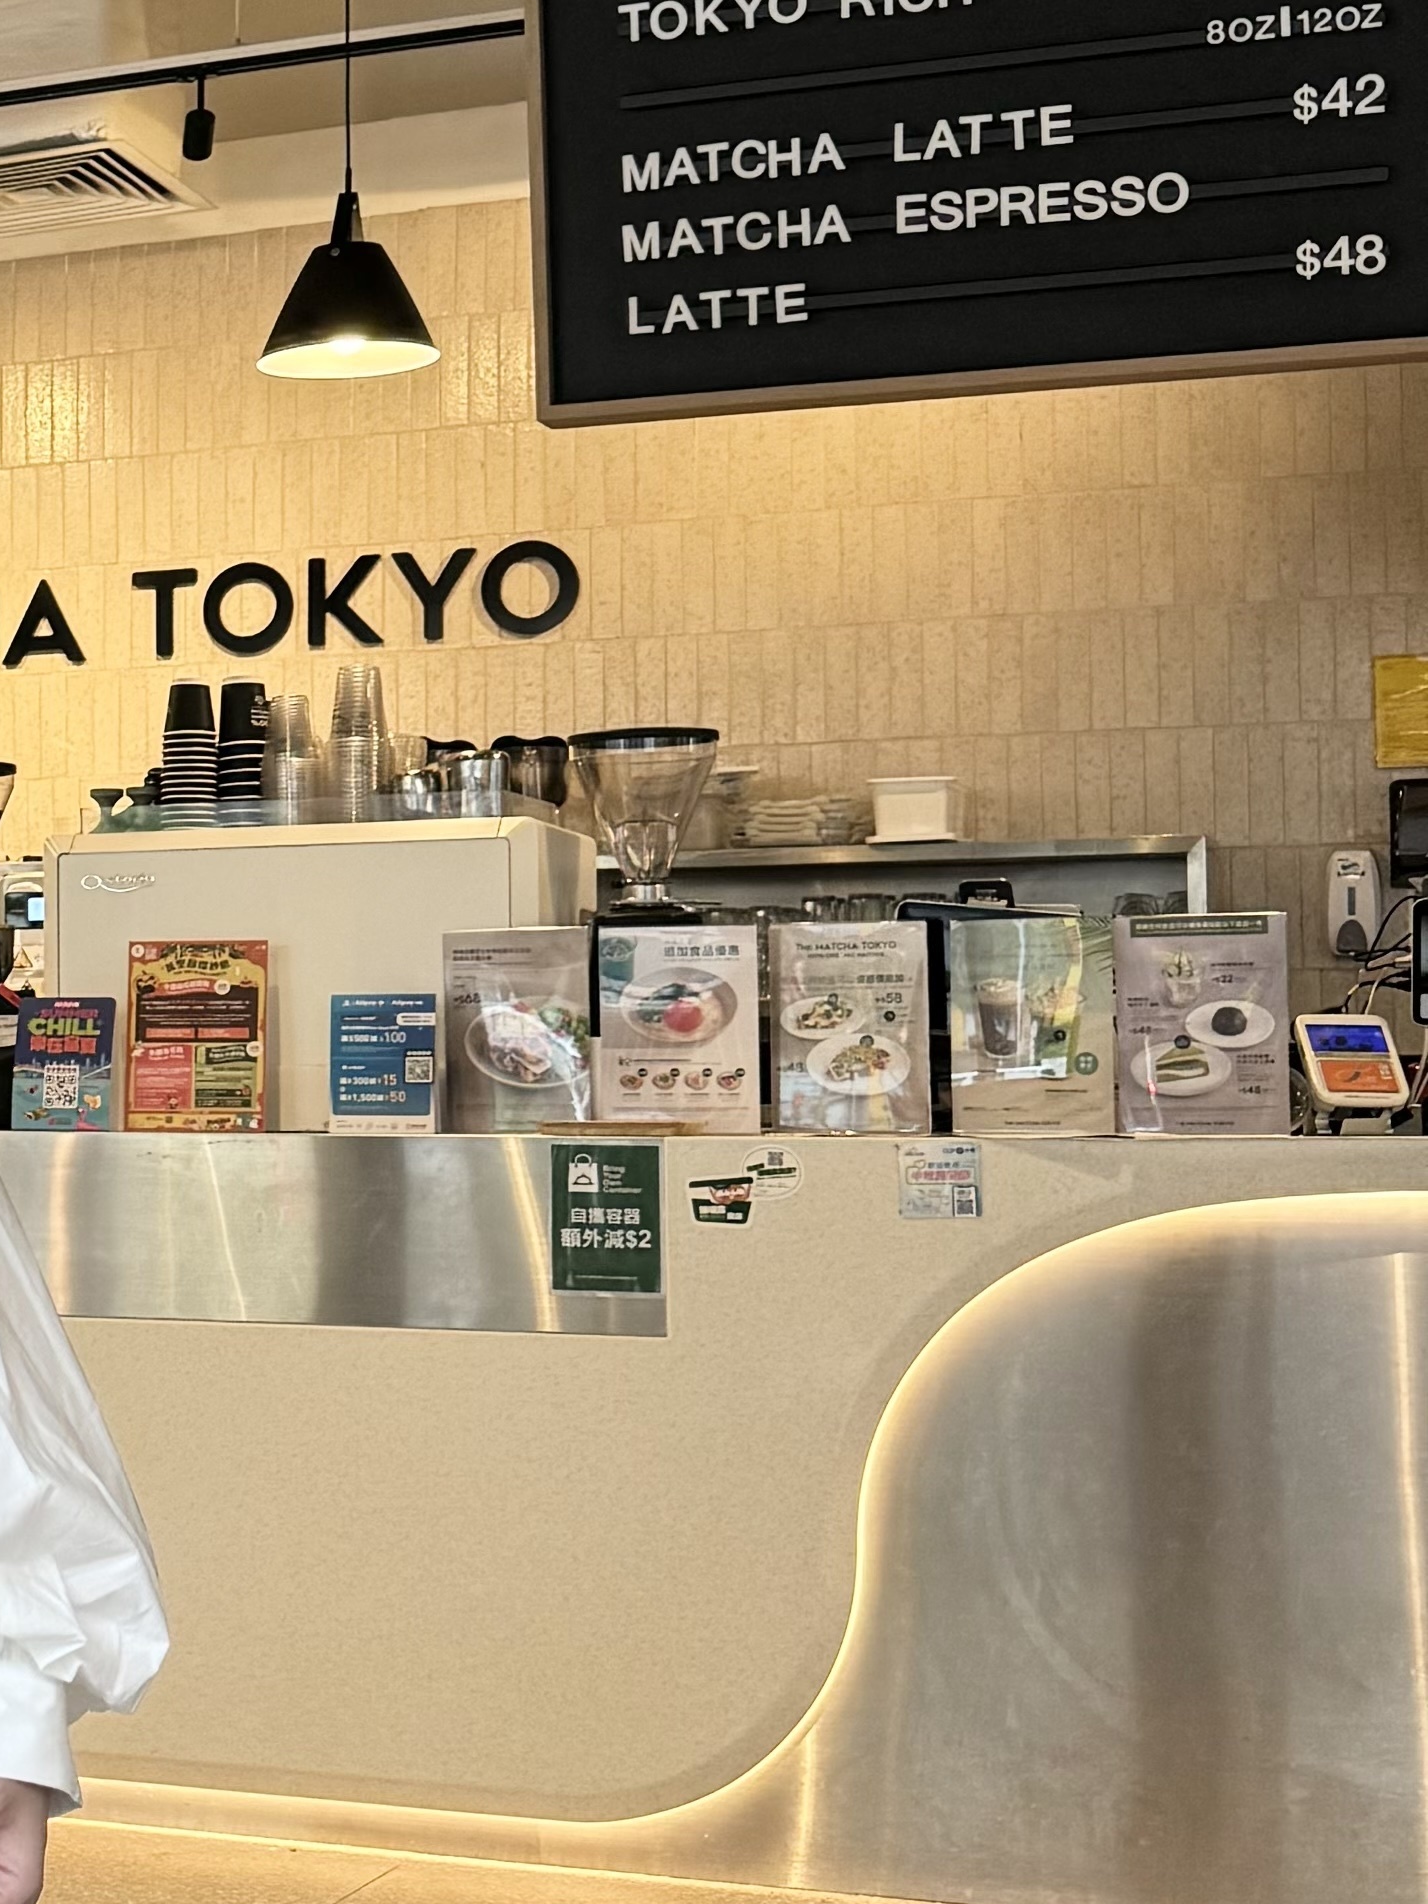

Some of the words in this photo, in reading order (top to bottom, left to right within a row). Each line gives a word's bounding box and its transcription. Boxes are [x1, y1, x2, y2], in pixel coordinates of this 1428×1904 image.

[623, 133, 846, 192] MATCHA
[894, 105, 1074, 161] LATTE
[1294, 74, 1386, 124] $42
[622, 205, 852, 262] MATCHA
[897, 173, 1190, 233] ESPRESSO
[629, 284, 808, 334] LATTE
[1296, 235, 1387, 280] $48
[132, 541, 580, 658] TOKYO
[815, 942, 858, 951] MATCHA
[862, 941, 897, 950] TOKYO
[27, 1018, 101, 1036] CHILL
[560, 1227, 652, 1249] 額外減$2
